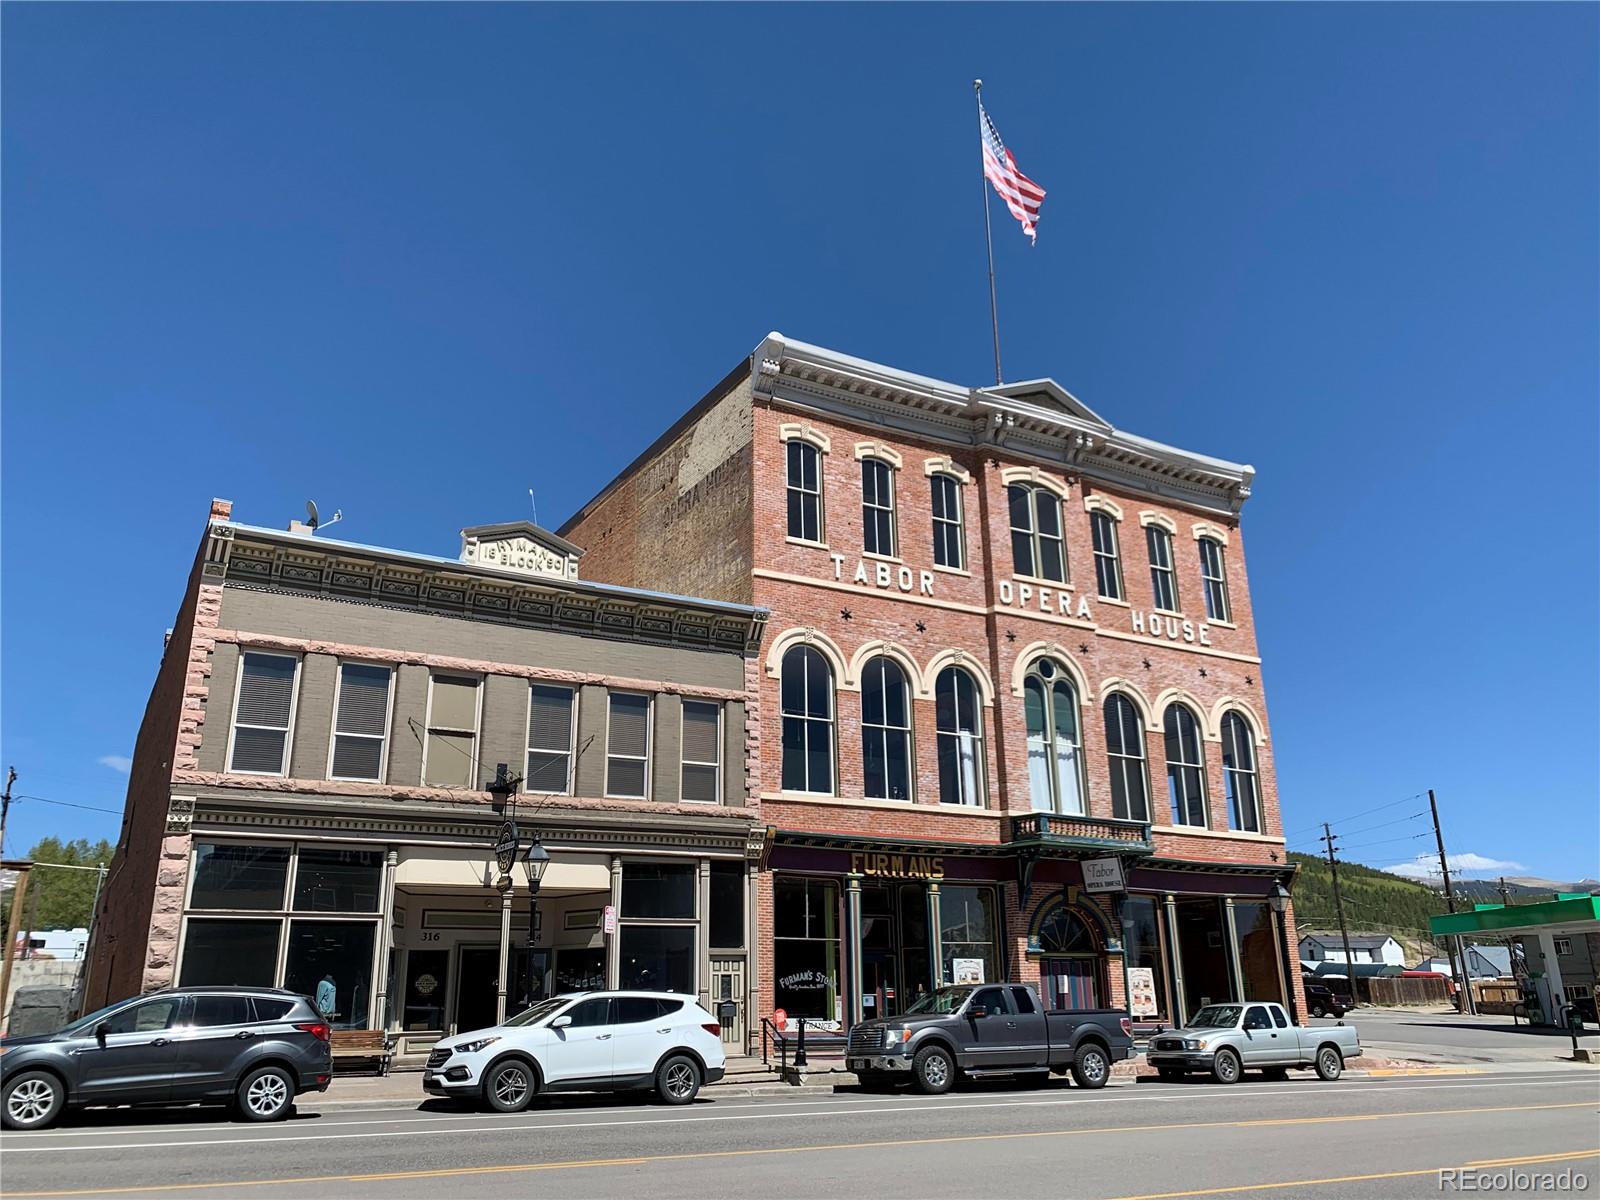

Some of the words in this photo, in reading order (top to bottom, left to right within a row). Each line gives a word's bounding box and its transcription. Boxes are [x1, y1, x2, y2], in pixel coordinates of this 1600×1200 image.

[500, 553, 543, 571] BLOCK
[830, 553, 934, 596] TABOR
[999, 581, 1091, 620] OPERA
[1131, 610, 1211, 646] HOUSE
[851, 852, 945, 878] FURMANS
[1087, 863, 1114, 878] Tabor
[421, 932, 440, 942] 316
[779, 969, 813, 989] FURMAN'S
[795, 1021, 833, 1030] ETRANCE
